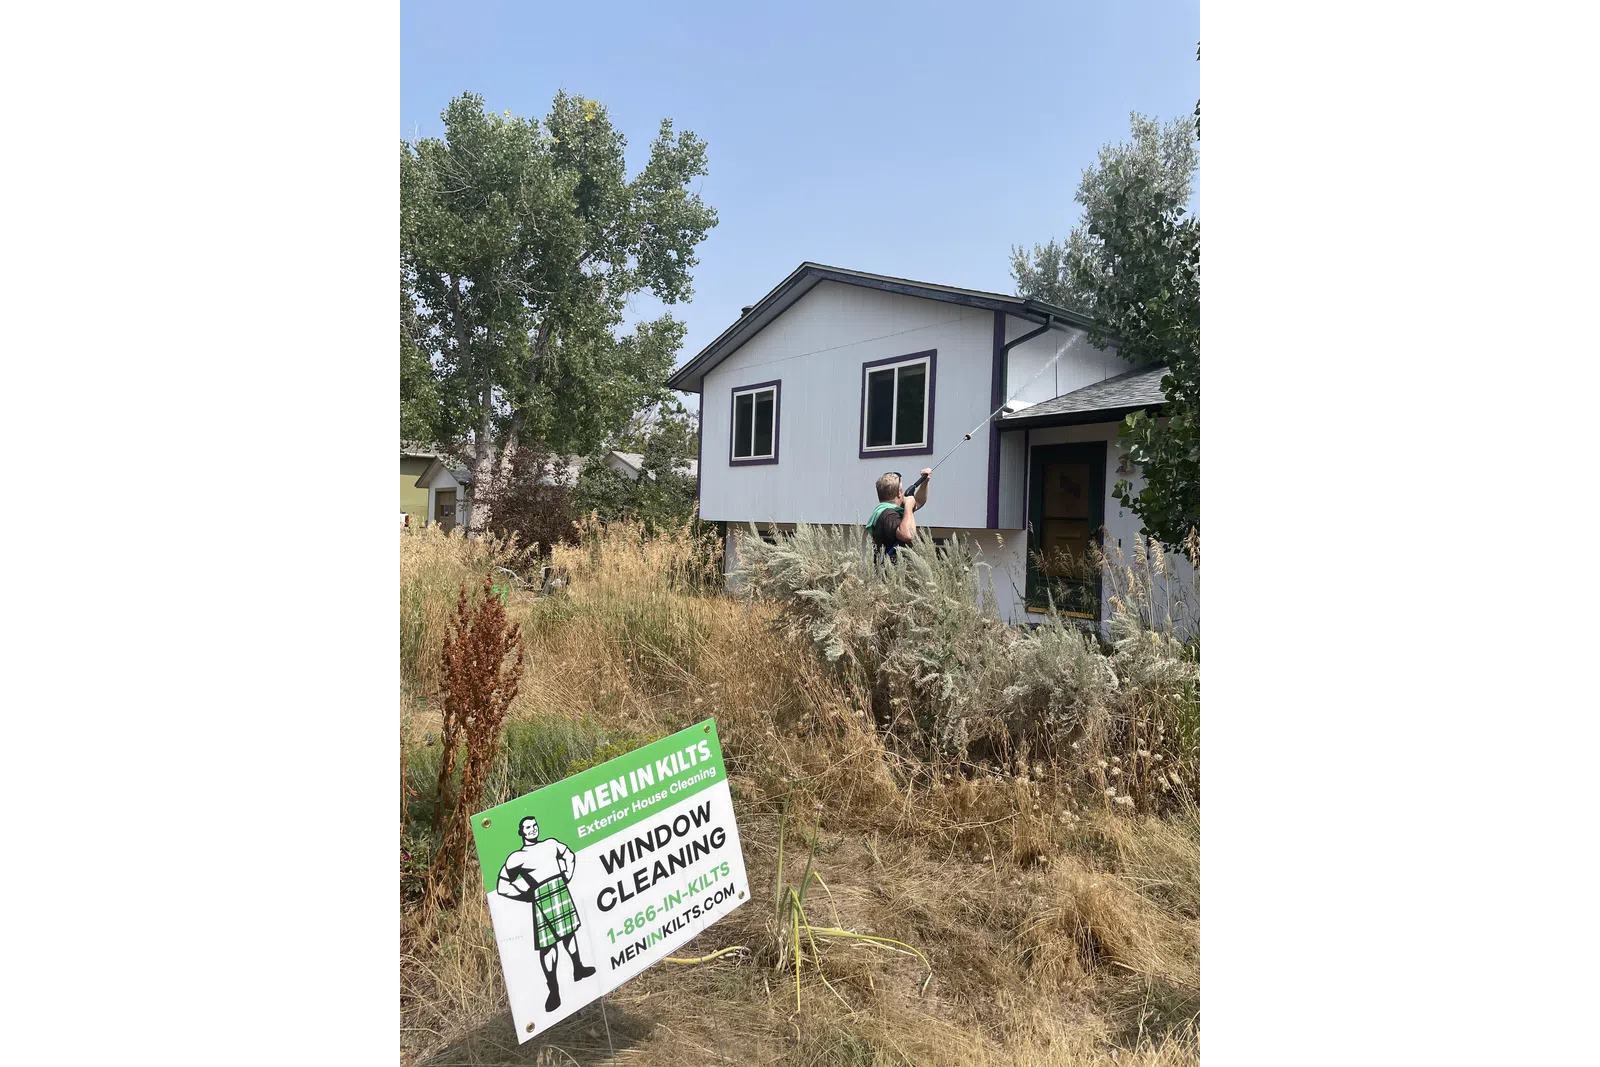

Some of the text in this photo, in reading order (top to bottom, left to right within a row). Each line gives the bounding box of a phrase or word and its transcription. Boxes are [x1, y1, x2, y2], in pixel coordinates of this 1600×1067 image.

[571, 740, 711, 820] MEN IN KILTS
[577, 766, 716, 838] Exterior House Cleaning
[597, 827, 726, 912] CLEANING
[599, 800, 710, 875] WINDOW
[607, 861, 730, 944] 1-866-IN-KILTS
[610, 882, 735, 970] MENINKILTS.COM
